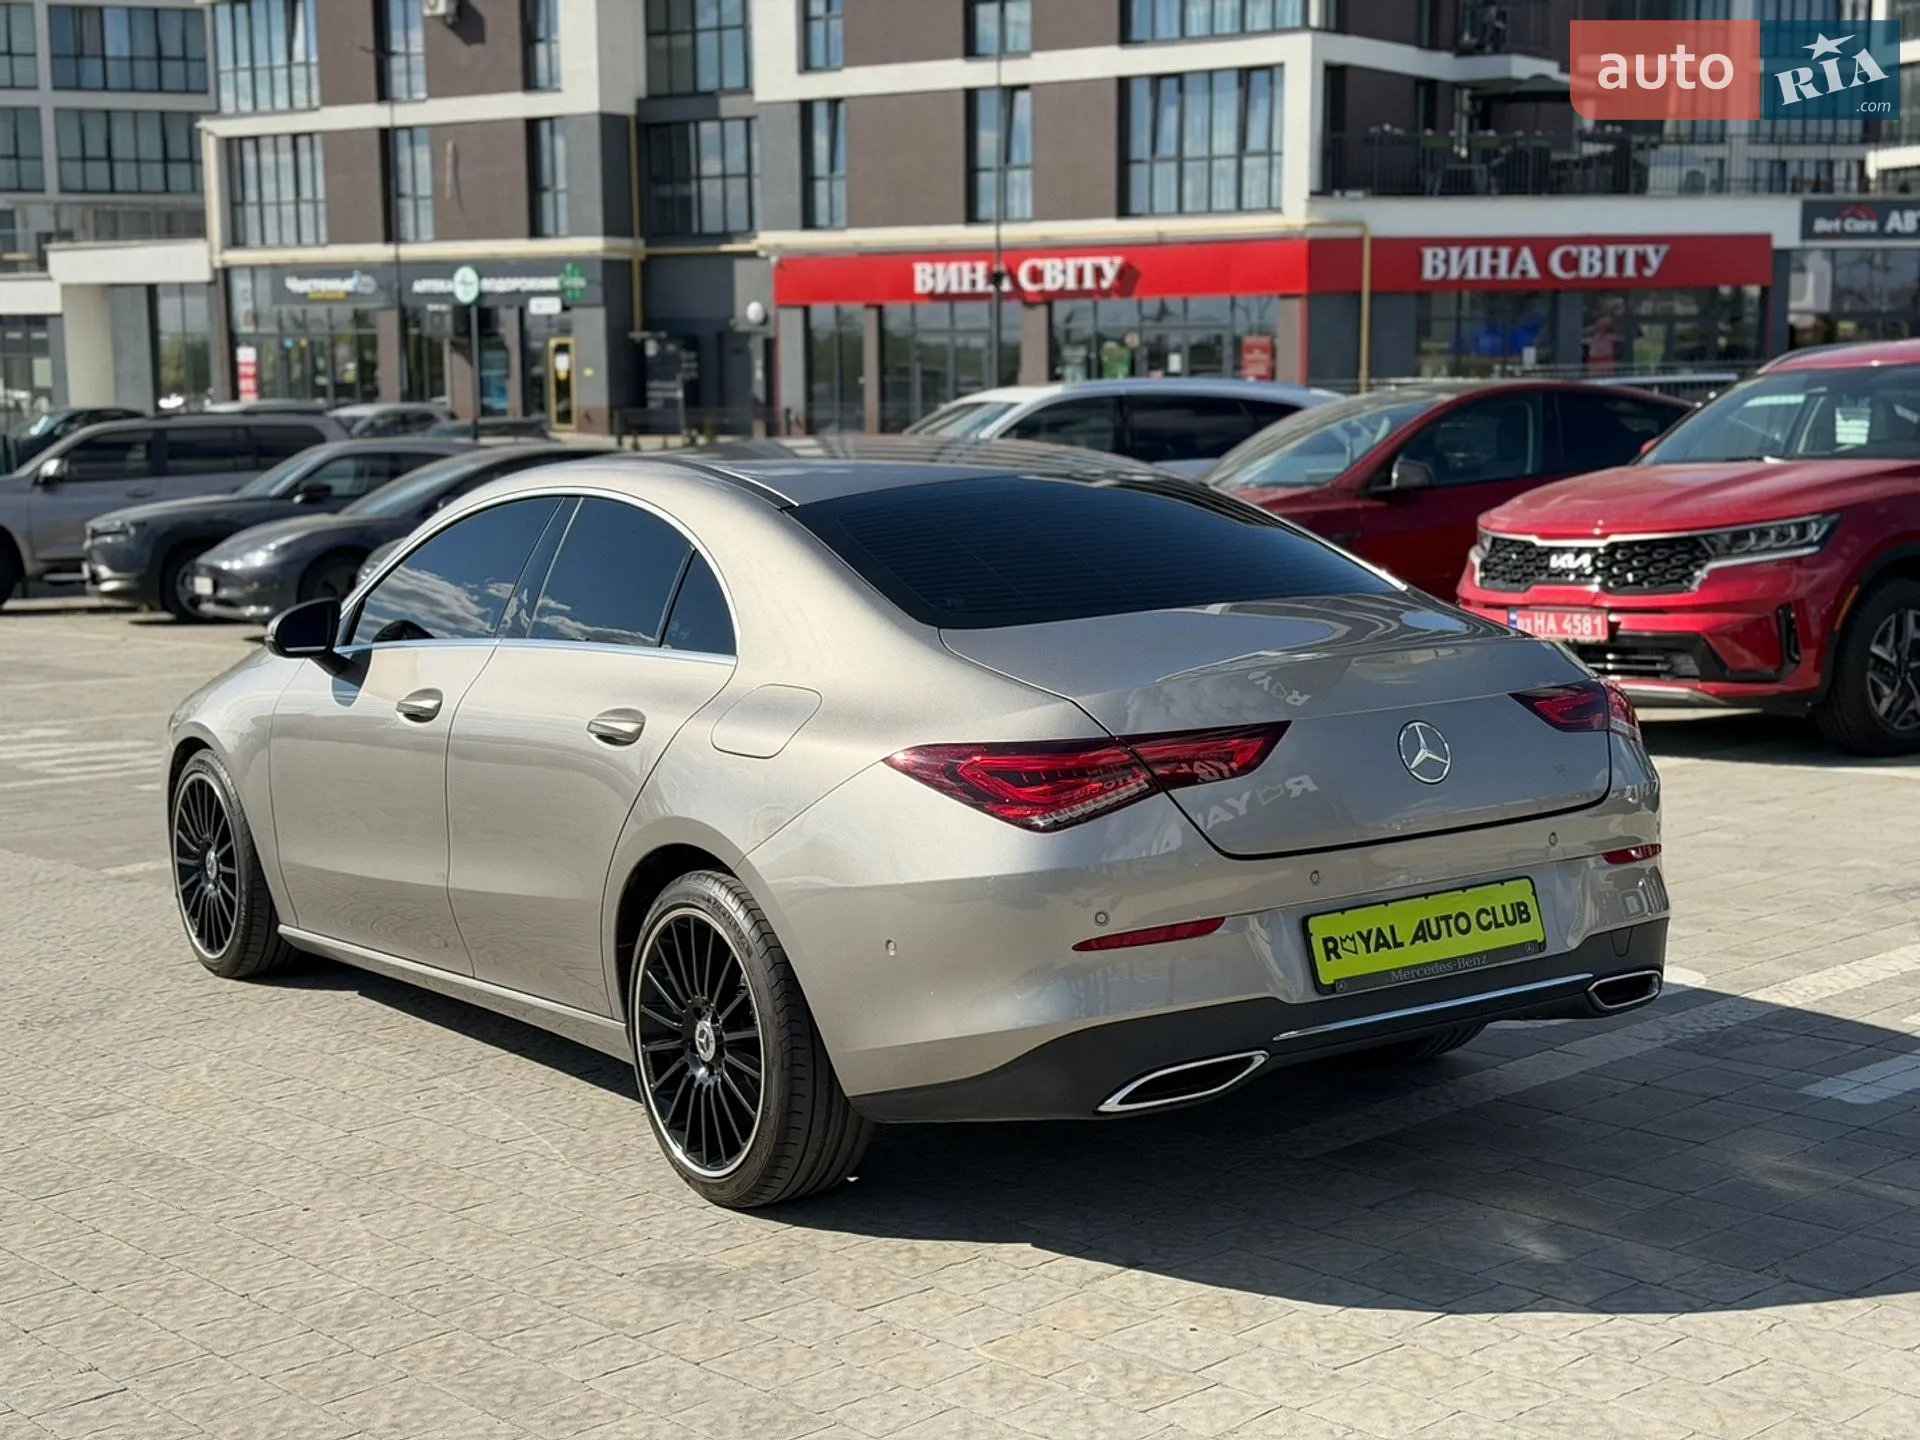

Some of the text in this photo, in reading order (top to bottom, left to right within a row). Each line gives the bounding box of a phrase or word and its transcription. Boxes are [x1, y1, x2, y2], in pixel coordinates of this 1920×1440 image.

[1017, 256, 1125, 292] СВІТУ
[1420, 244, 1670, 281] ВИНА СВІТУ
[1562, 613, 1603, 636] 4581
[1409, 911, 1472, 947] AUTO
[1474, 900, 1532, 933] CLUB
[1389, 955, 1488, 983] Mercedes-Benz
